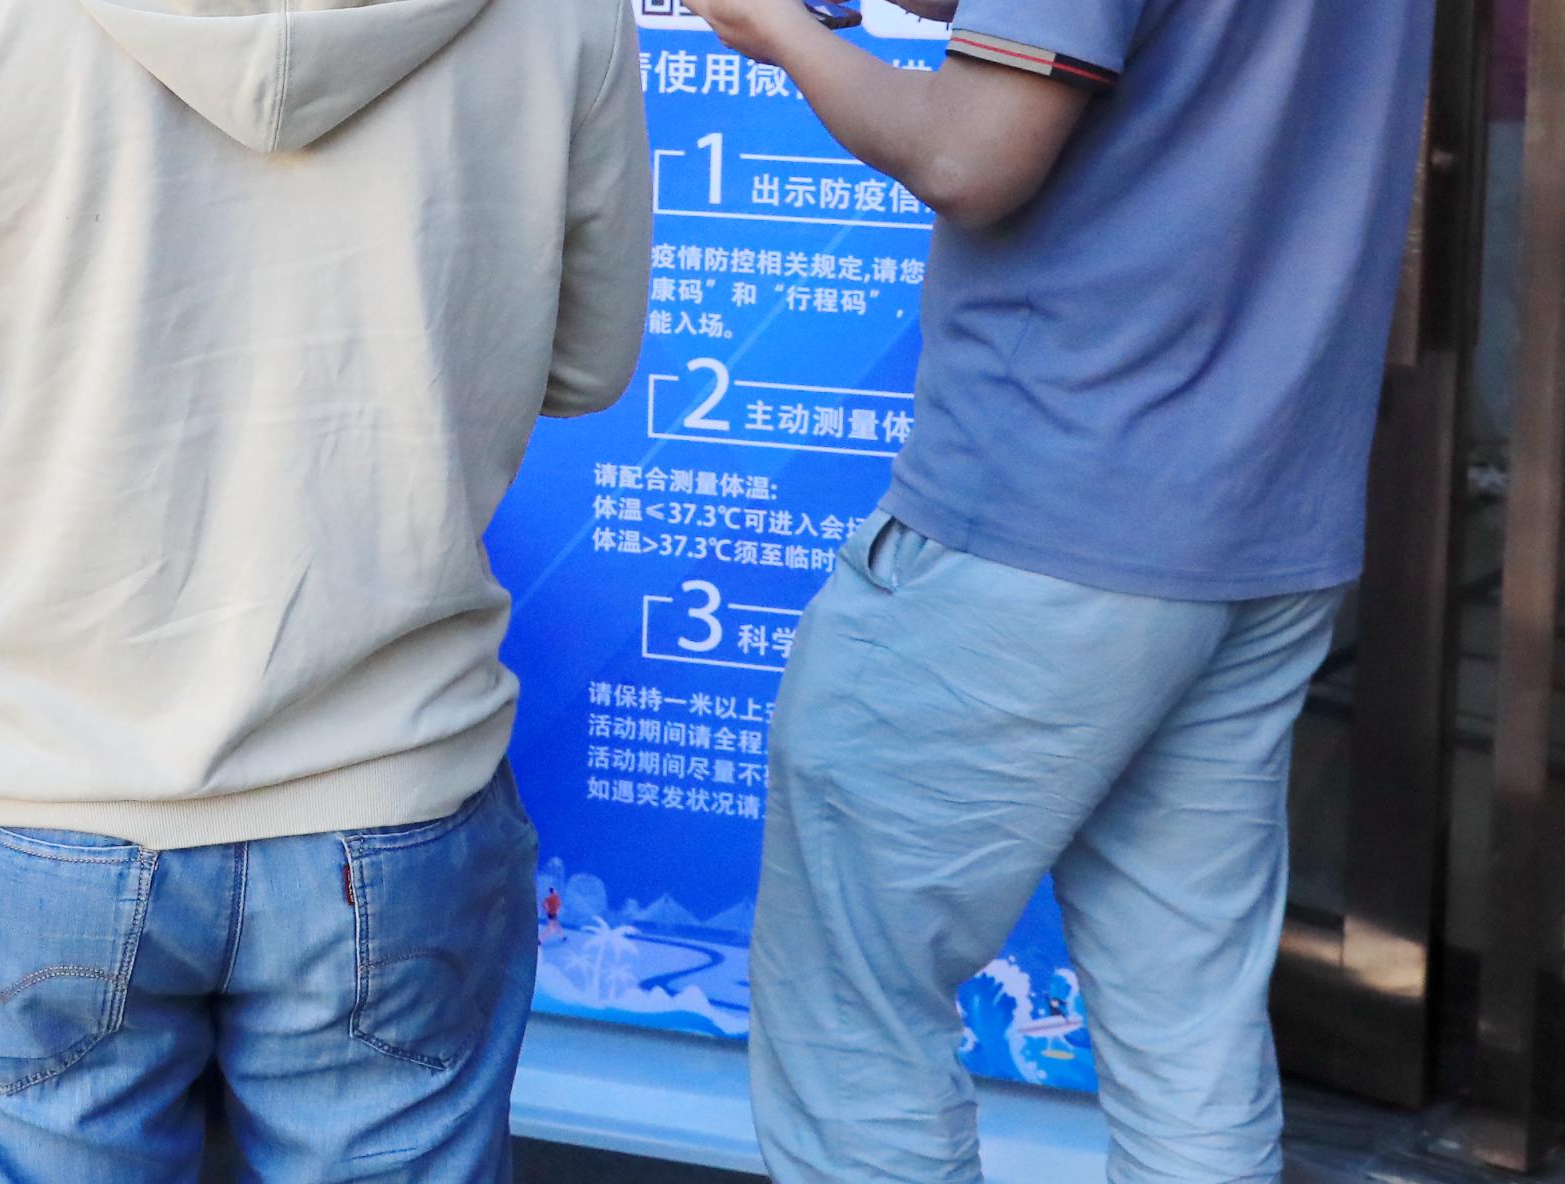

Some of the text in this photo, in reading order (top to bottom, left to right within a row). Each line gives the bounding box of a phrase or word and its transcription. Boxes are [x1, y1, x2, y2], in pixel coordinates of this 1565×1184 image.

[640, 50, 804, 99] 使用微
[696, 132, 931, 214] 1 出示防疫信
[683, 357, 914, 443] 2 主动测量体
[678, 579, 796, 658] 3 科学
[588, 713, 768, 754] 活动期间请全程
[587, 745, 769, 788] 活动期间尽量不
[586, 776, 765, 820] 如遇突发状况请
